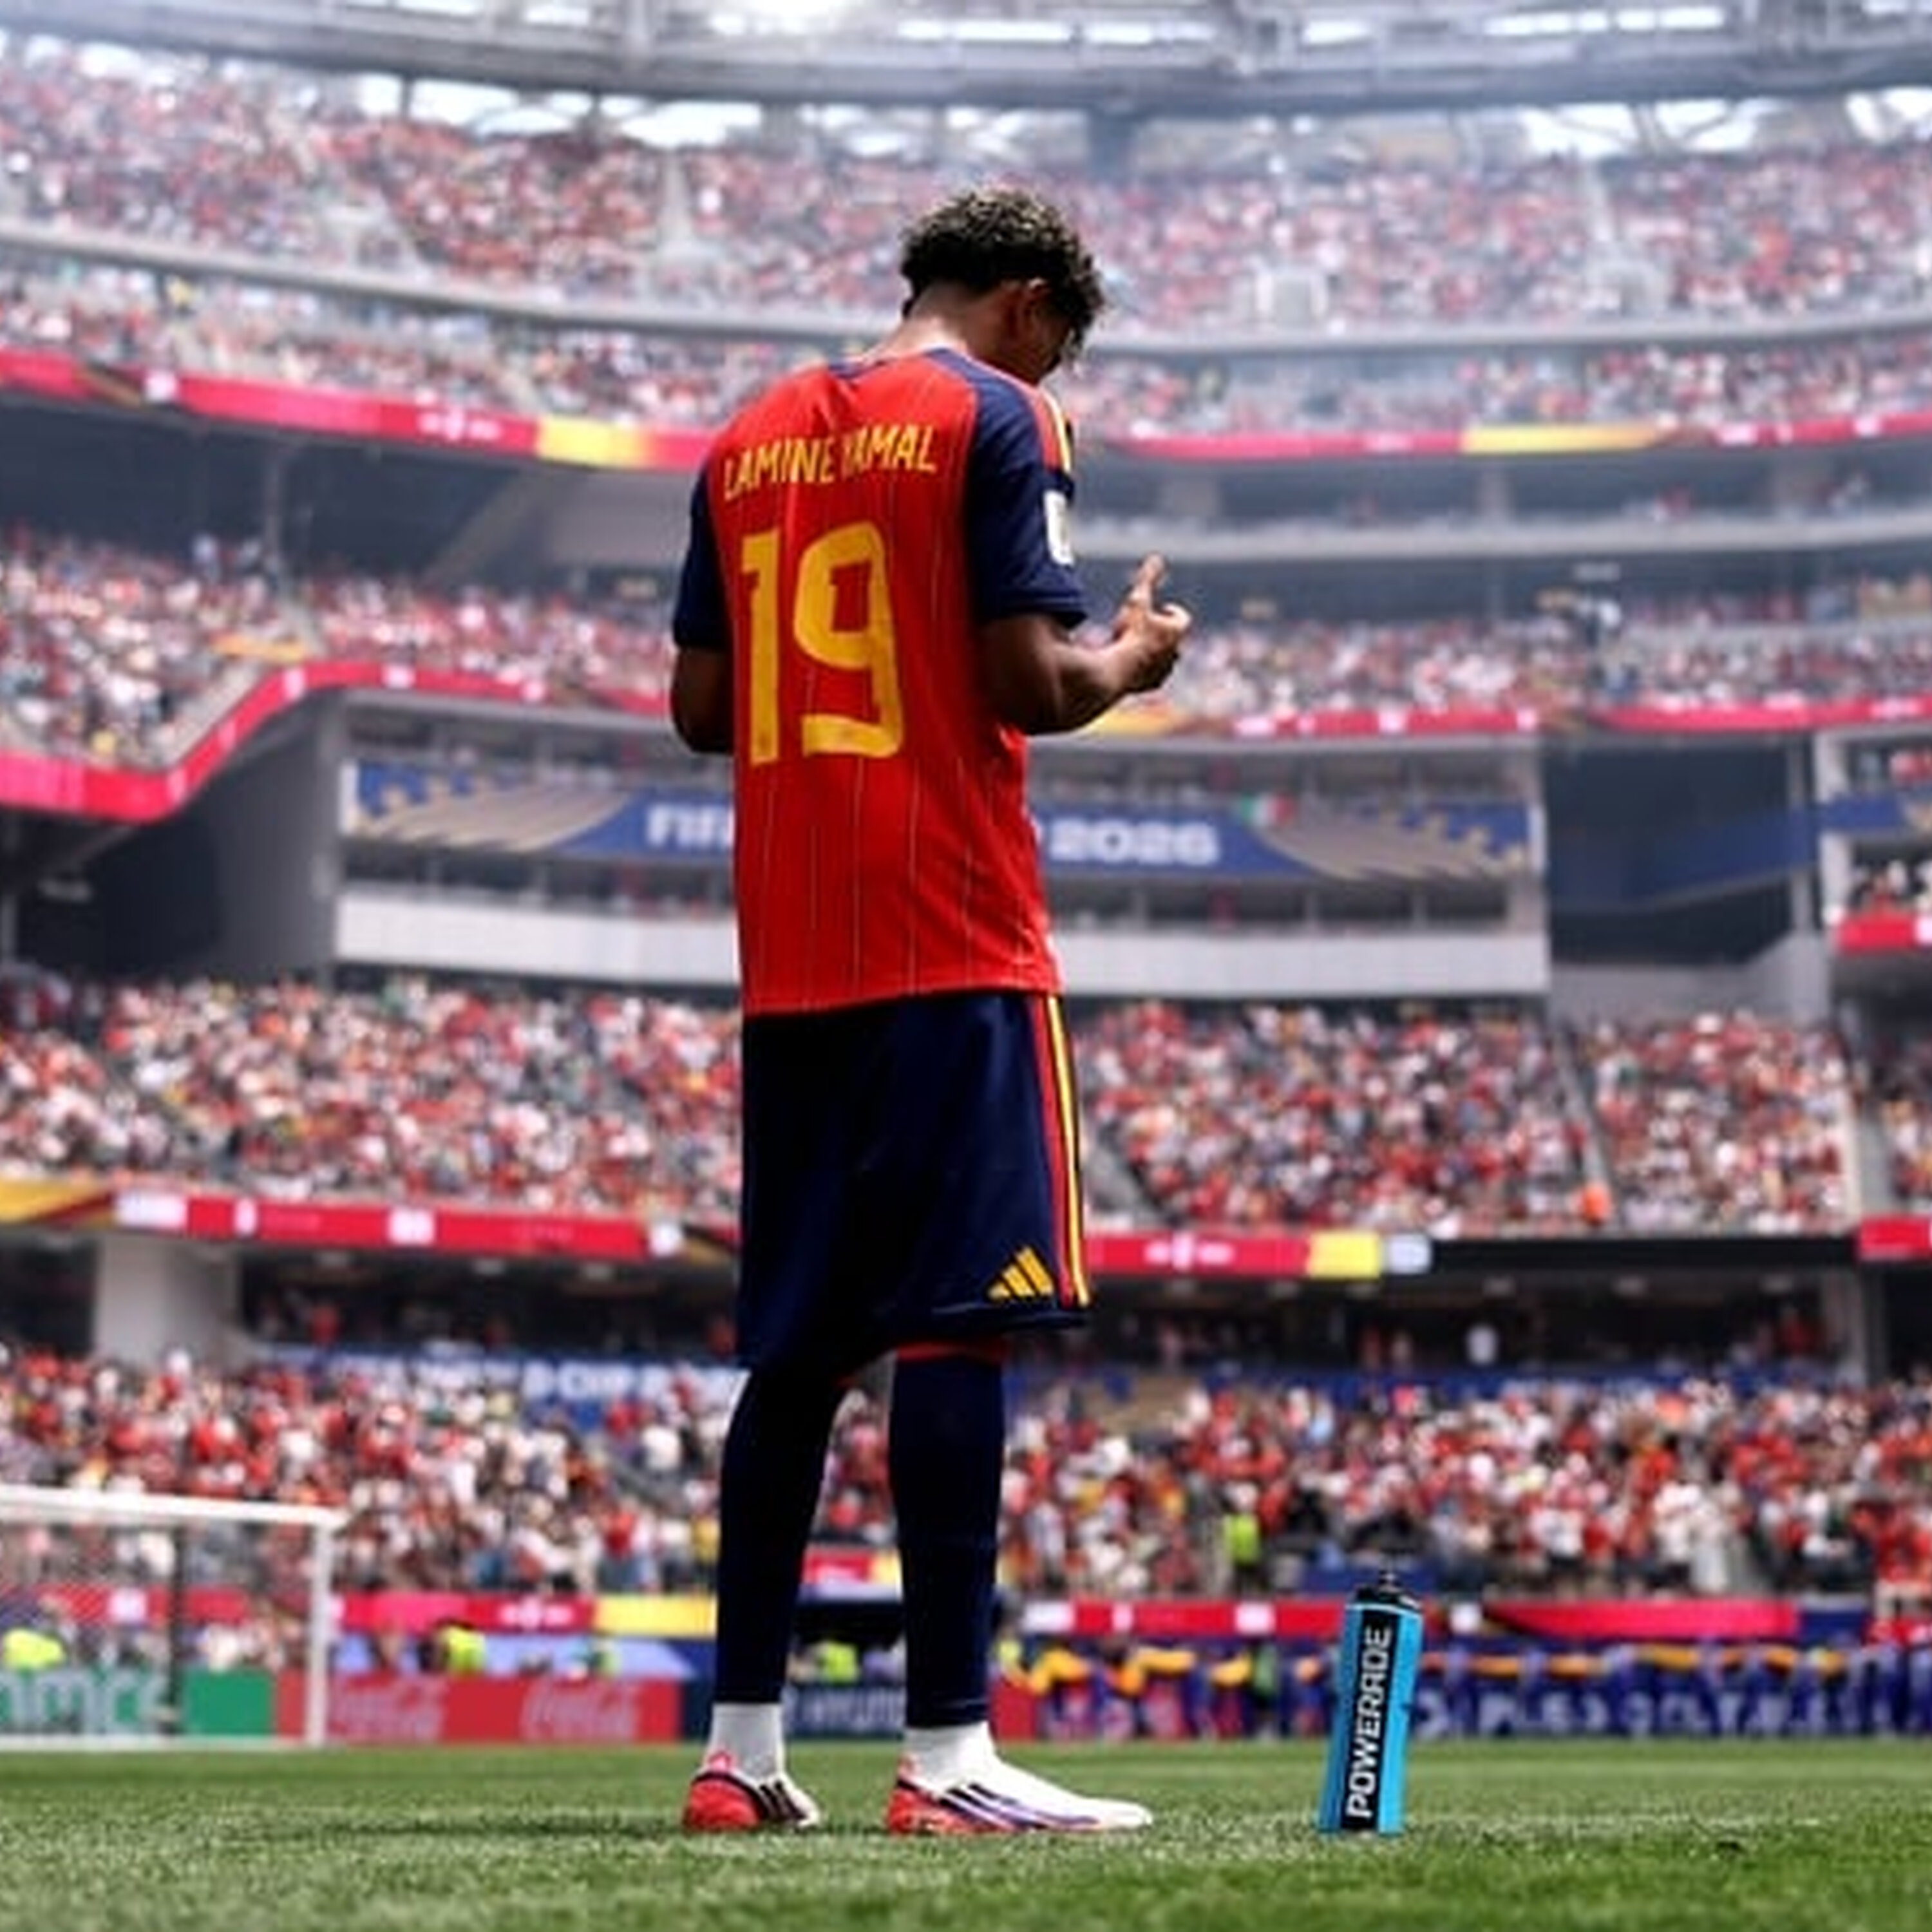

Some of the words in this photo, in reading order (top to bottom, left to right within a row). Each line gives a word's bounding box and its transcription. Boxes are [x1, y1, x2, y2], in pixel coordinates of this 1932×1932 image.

[724, 437, 835, 495] LAMINE
[741, 521, 903, 768] 19
[1050, 817, 1220, 865] 2026
[1345, 1625, 1393, 1819] POWERADE
